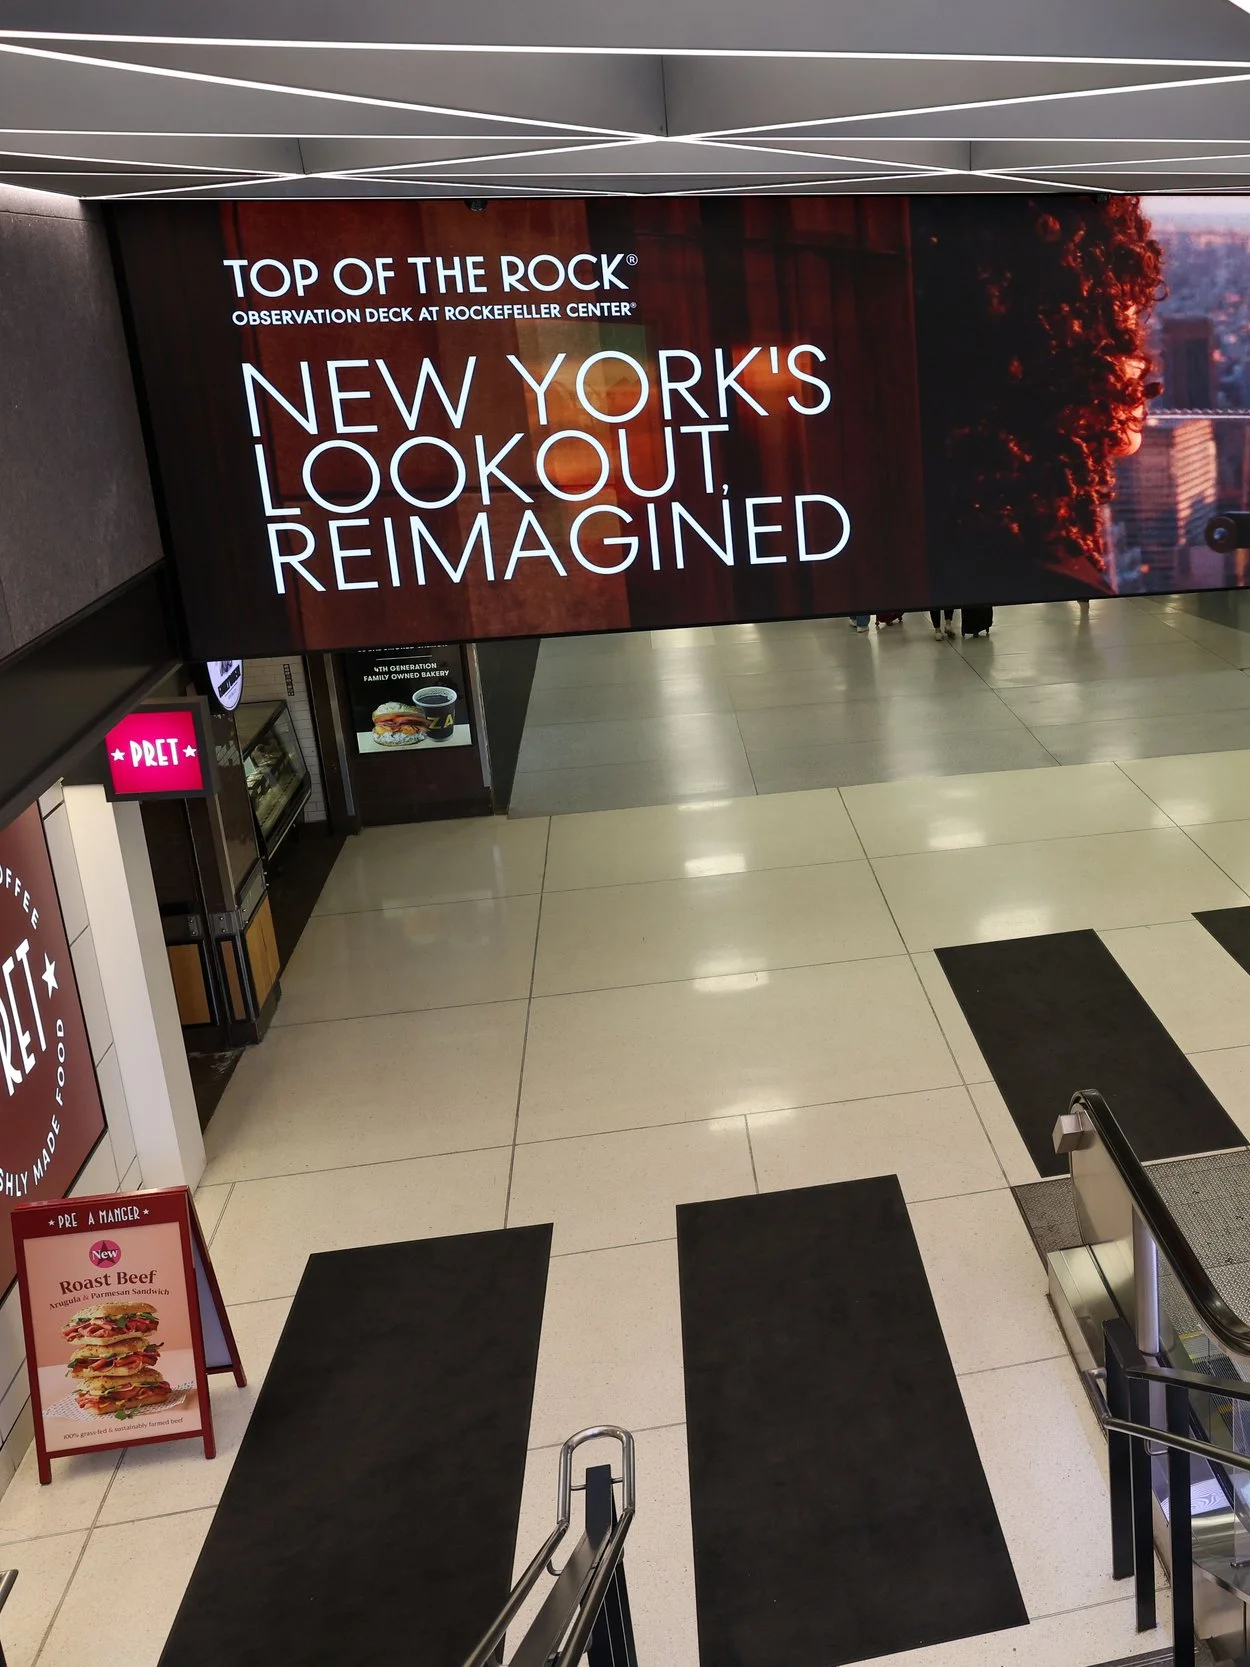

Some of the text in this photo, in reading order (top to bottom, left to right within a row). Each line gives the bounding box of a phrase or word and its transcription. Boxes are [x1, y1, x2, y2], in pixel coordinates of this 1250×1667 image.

[223, 258, 318, 298] TOP
[334, 257, 395, 295] OF
[408, 256, 488, 293] THE
[232, 309, 360, 325] OBSERVATION
[365, 307, 414, 322] DECK
[419, 306, 439, 321] AT
[445, 303, 561, 320] ROCKEFELLER
[242, 345, 831, 436] NEW YORK'S
[255, 423, 730, 517] LOOKOUT,
[267, 494, 851, 594] REIMAGINED
[363, 670, 450, 682] FAMILY OWNED BAKERY
[373, 663, 437, 673] 4TH GENERATION
[129, 738, 179, 767] PRET
[33, 1114, 60, 1185] MADE
[56, 1018, 65, 1106] FOOD
[88, 1211, 95, 1226] A
[99, 1206, 141, 1224] MANGER
[91, 1249, 119, 1260] New
[59, 1270, 157, 1295] Roast Beef
[49, 1288, 170, 1310] Arugula & Parmesan Sandwich
[114, 1422, 148, 1432] sustainably
[149, 1419, 170, 1427] farmed
